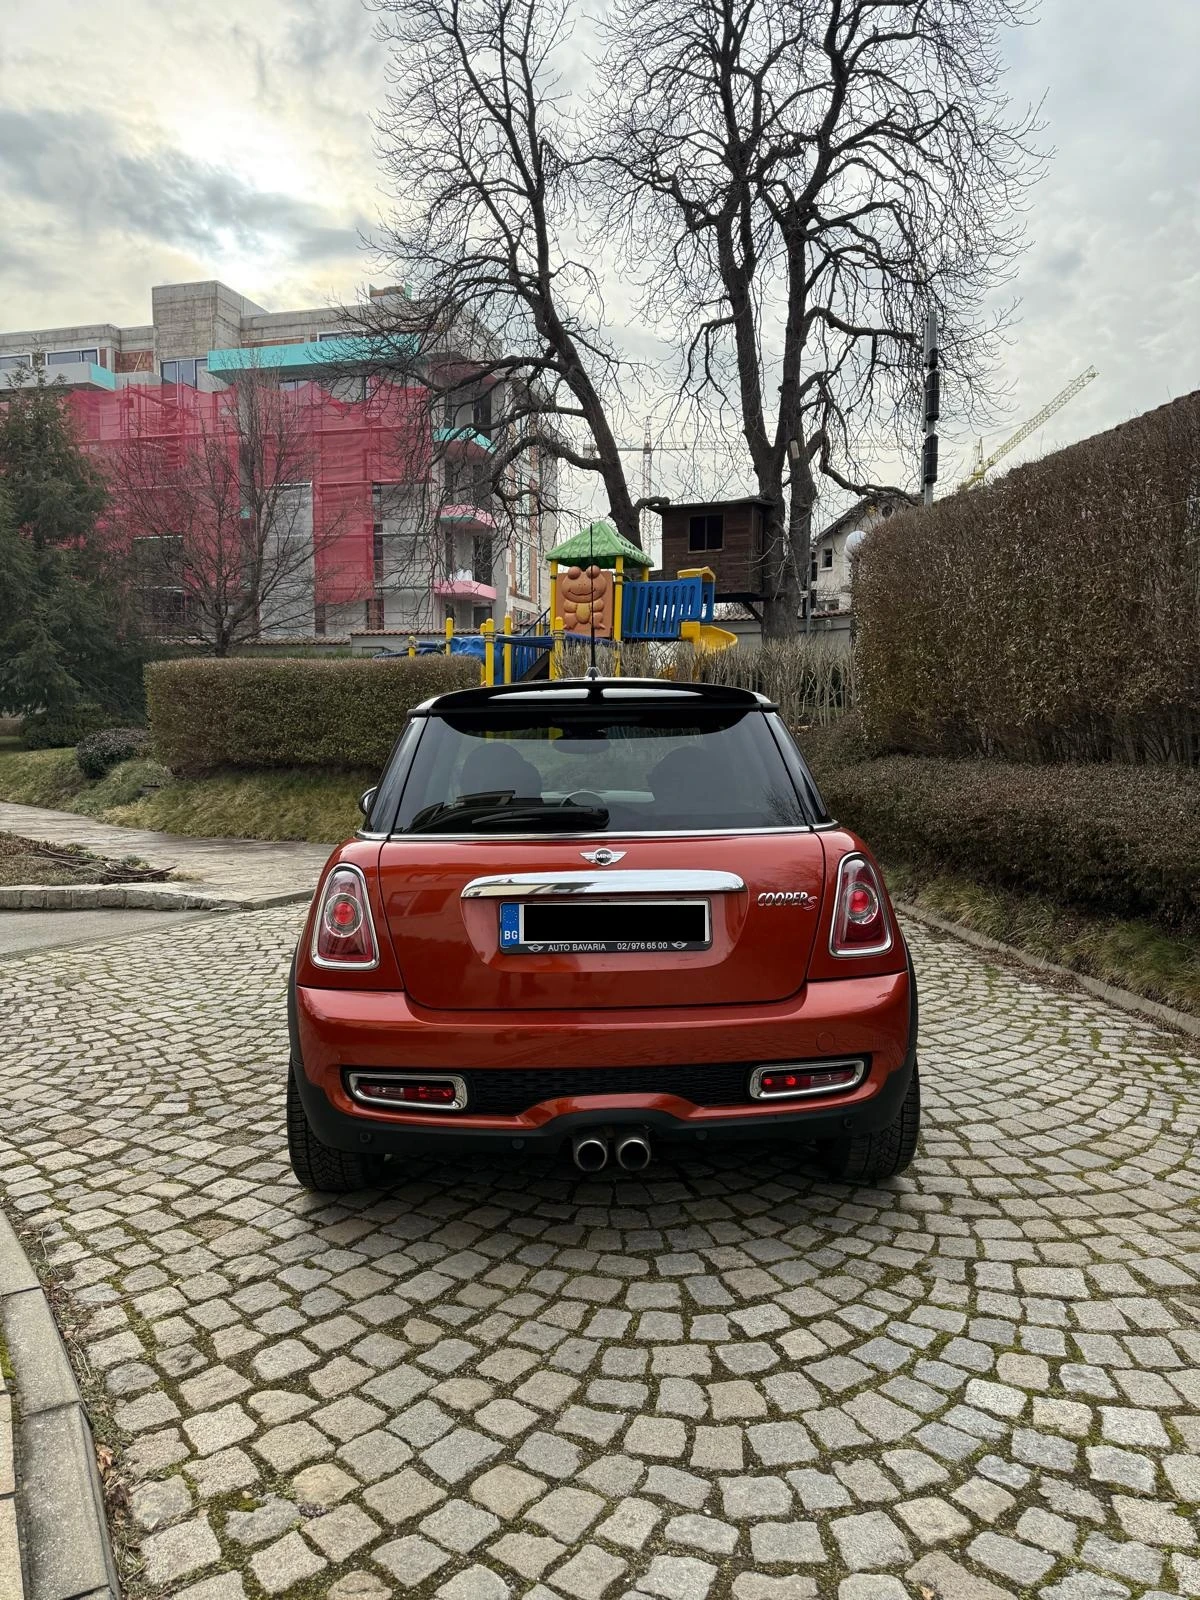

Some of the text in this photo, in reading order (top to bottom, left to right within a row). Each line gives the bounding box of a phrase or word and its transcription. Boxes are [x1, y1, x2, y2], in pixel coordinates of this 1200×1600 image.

[757, 891, 818, 911] COOPER S
[504, 930, 518, 940] BG
[547, 943, 571, 952] AUTO
[572, 943, 607, 952] BAVARIA
[657, 941, 668, 950] 00
